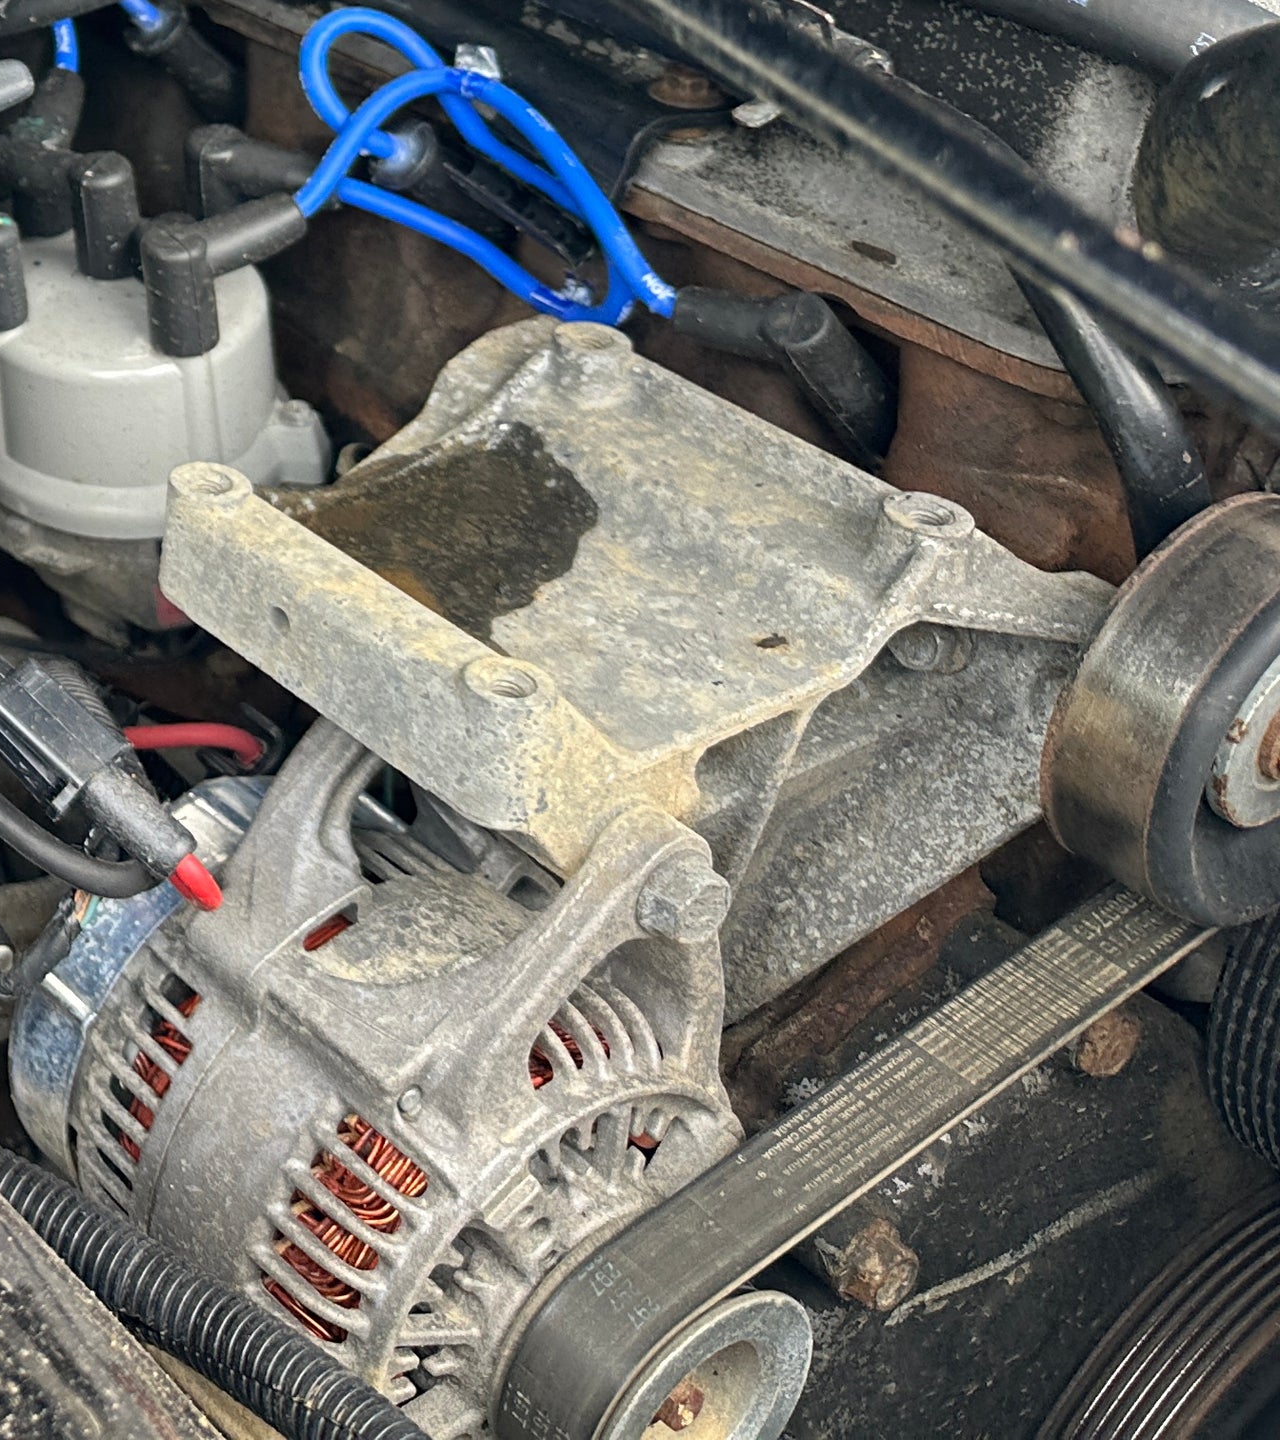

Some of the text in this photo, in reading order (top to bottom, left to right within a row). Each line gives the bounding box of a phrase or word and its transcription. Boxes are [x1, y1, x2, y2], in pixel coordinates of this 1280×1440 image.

[770, 1108, 810, 1138] CANADA
[810, 1090, 856, 1126] FABRIQUE
[760, 1130, 800, 1161] CANADA
[792, 1124, 831, 1155] CANADA
[801, 1162, 840, 1193] CANADA
